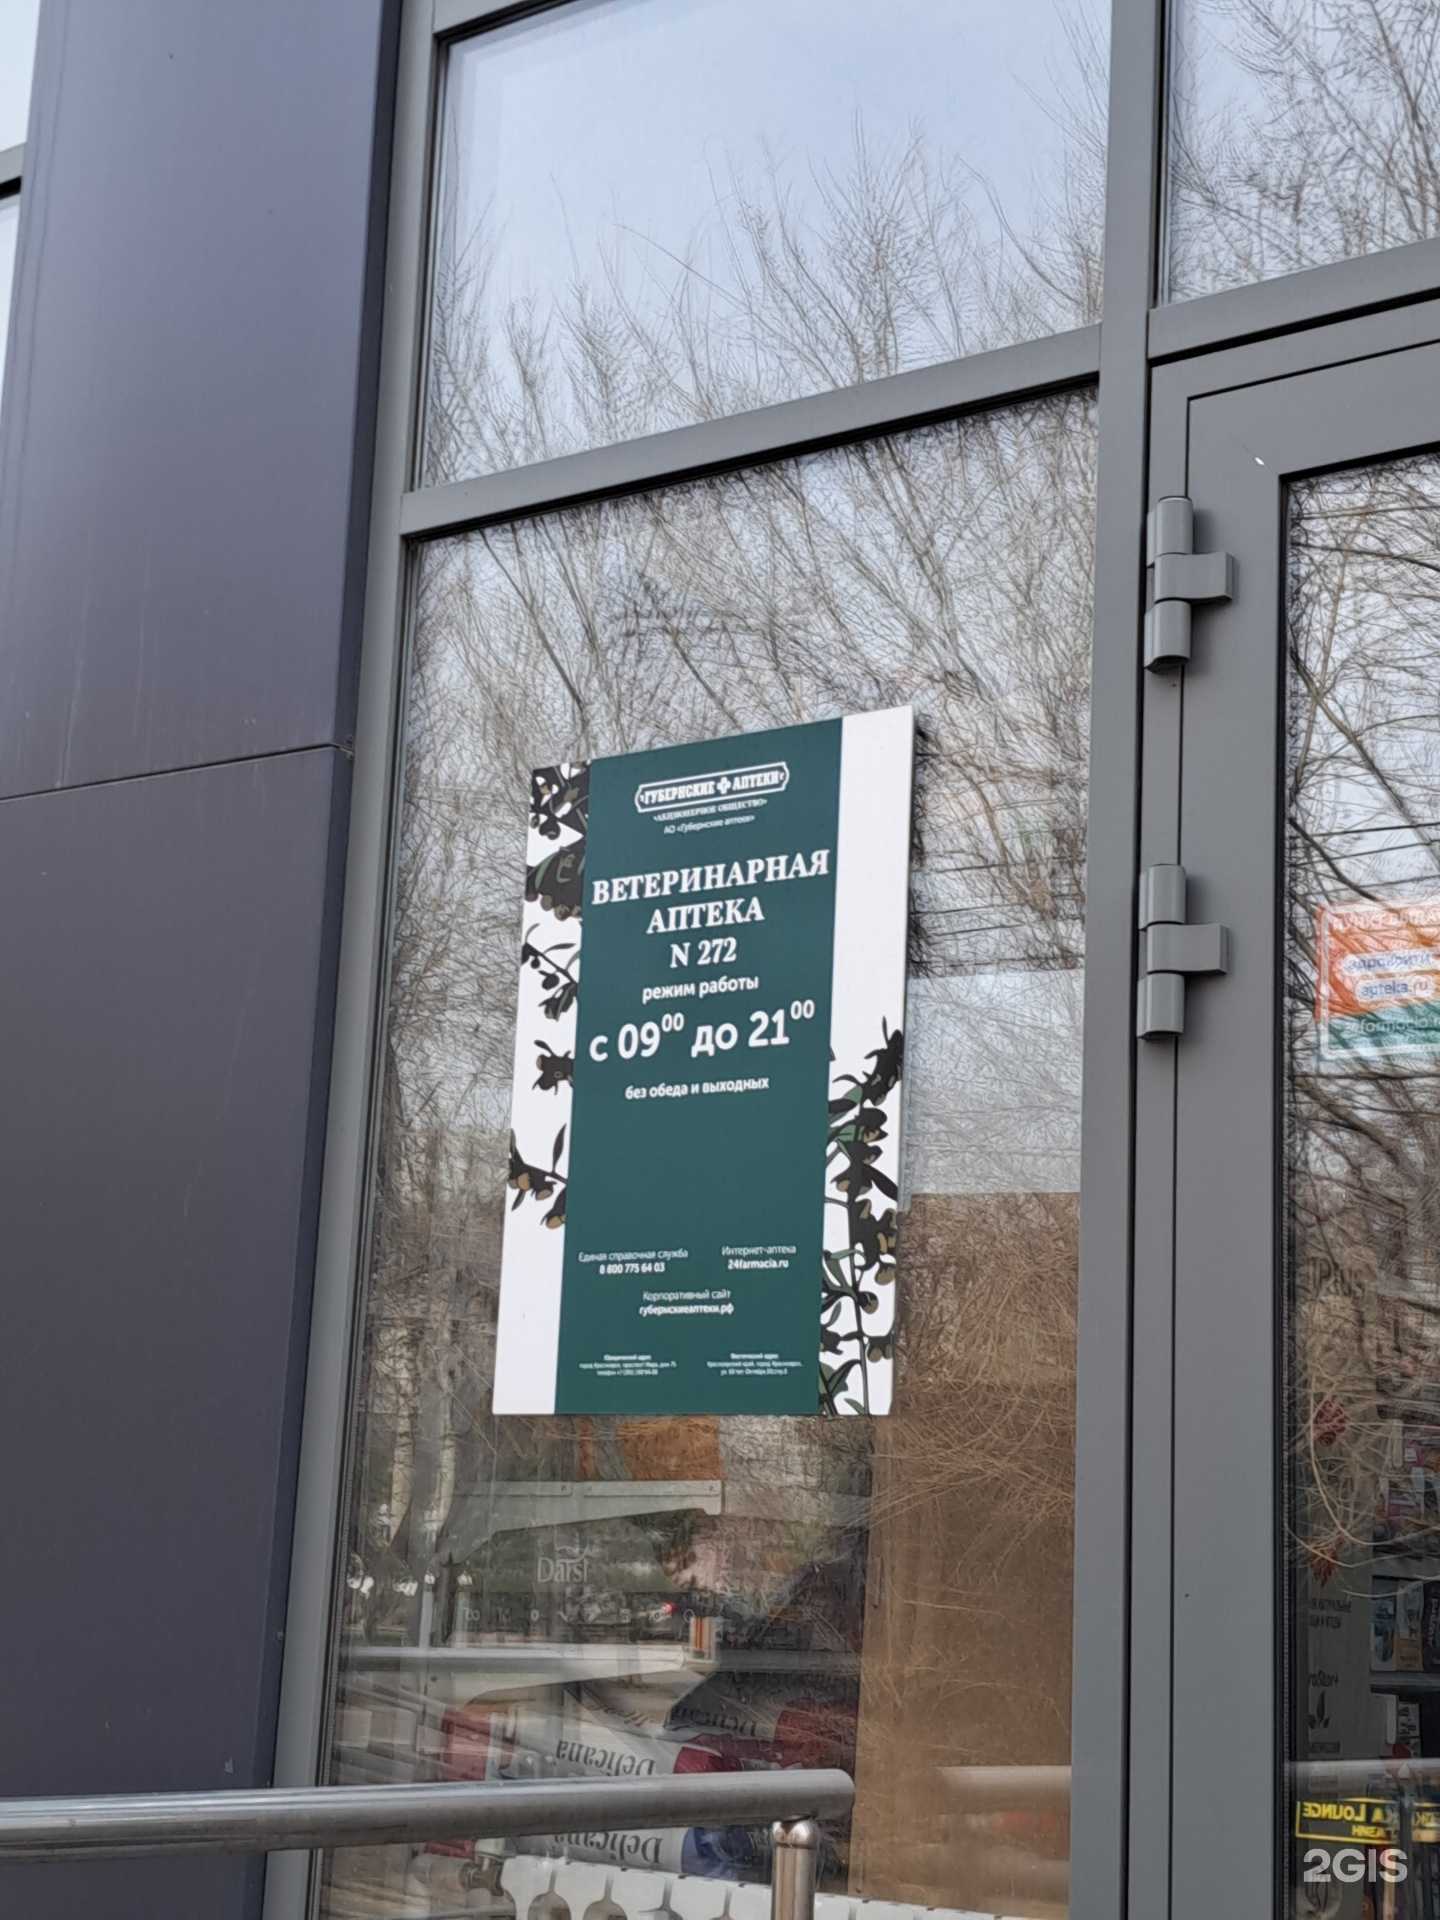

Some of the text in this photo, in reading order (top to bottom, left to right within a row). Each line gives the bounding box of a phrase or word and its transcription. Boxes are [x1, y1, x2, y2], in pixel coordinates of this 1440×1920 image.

[643, 770, 780, 804] ГУБЕРНСКИЕ АПТЕКИ
[591, 849, 830, 905] ВЕТЕРИНАРНАЯ
[645, 896, 765, 934] АПТЕКА
[669, 936, 737, 968] N 272
[642, 975, 759, 1005] режим работы
[690, 1022, 738, 1058] до
[625, 1076, 769, 1100] без обеда и выходных
[624, 1262, 640, 1273] 775
[727, 1258, 789, 1270] 24farmacia.ru
[555, 1740, 656, 1777] Delicana
